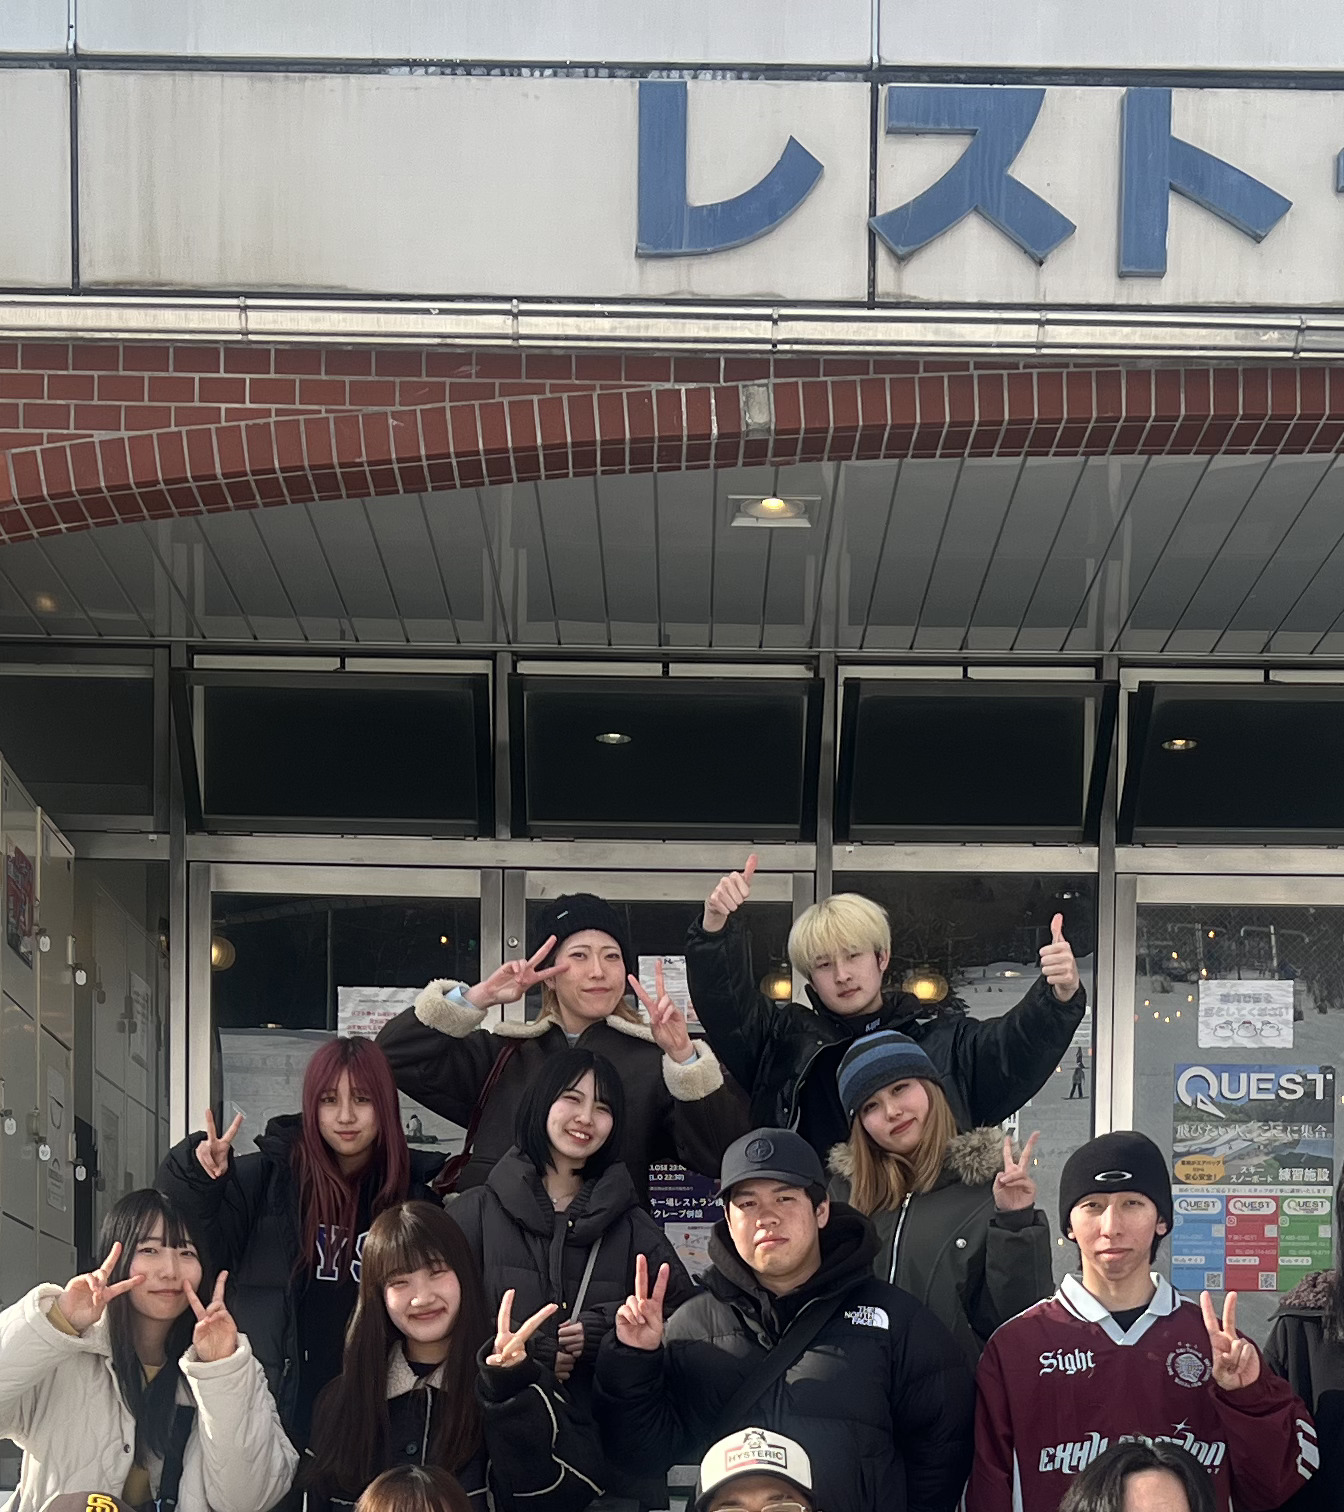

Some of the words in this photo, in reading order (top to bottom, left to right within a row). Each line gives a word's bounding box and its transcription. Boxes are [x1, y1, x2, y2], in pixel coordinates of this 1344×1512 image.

[1177, 1066, 1333, 1119] QUEST
[1278, 1168, 1330, 1182] 練習施設
[1178, 1199, 1217, 1212] QUEST
[1233, 1199, 1272, 1212] QUEST
[1287, 1199, 1326, 1212] QUEST
[844, 1310, 874, 1320] NORTH
[852, 1317, 873, 1326] FACE
[1039, 1348, 1096, 1377] Sight
[728, 1449, 784, 1463] HYSTERIC
